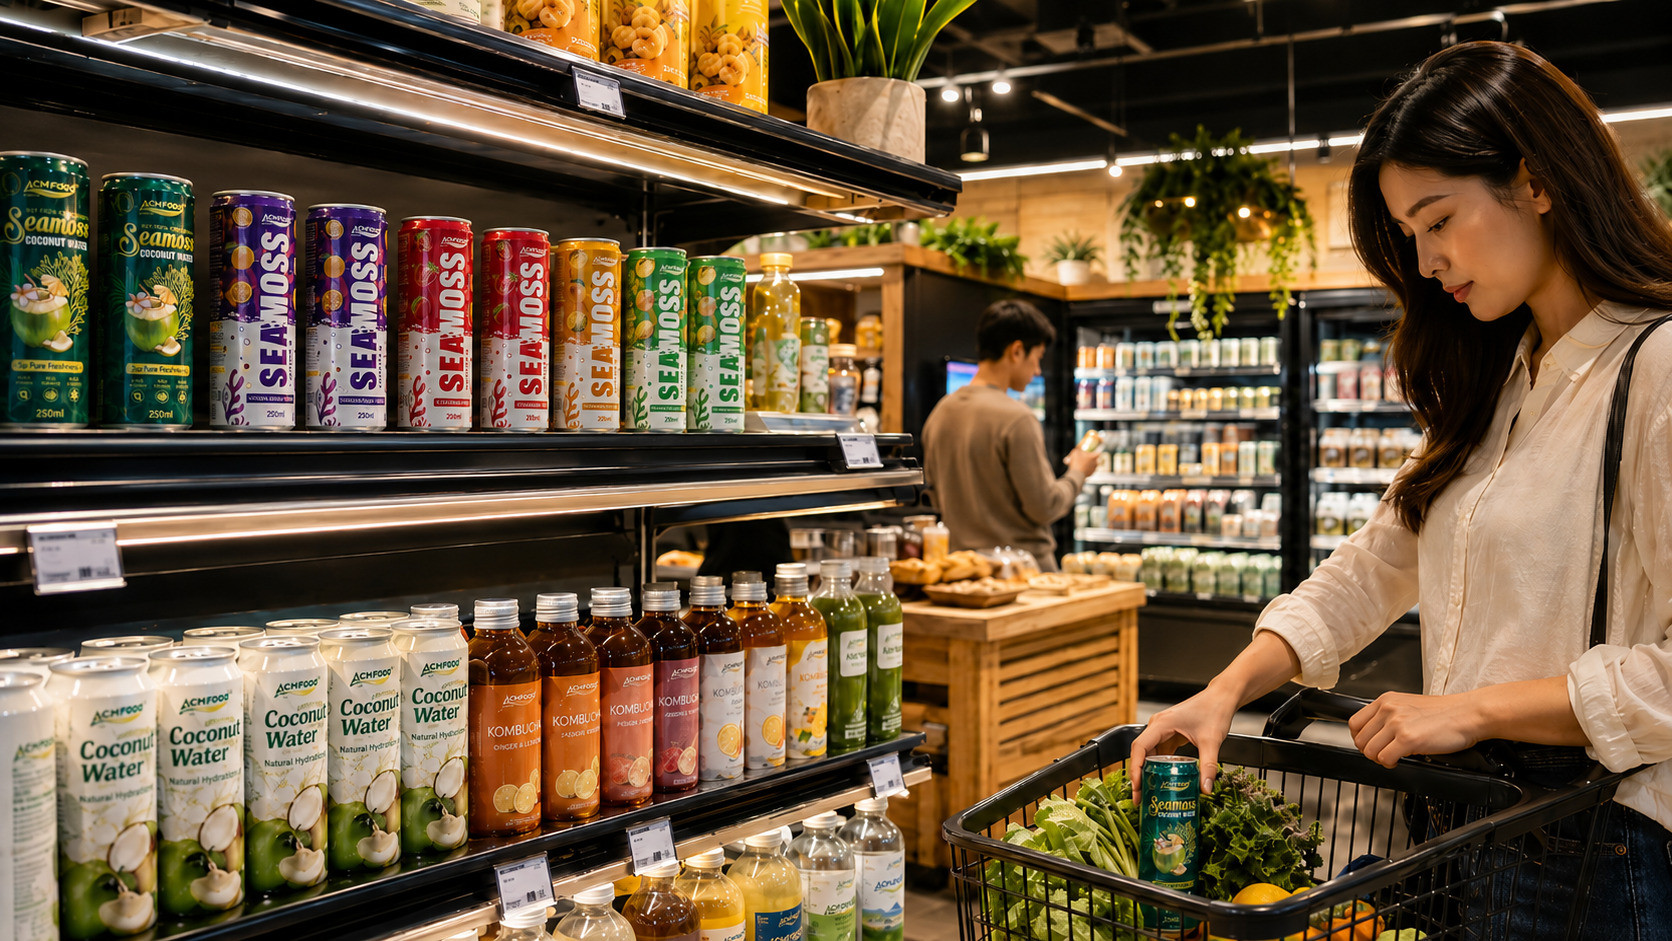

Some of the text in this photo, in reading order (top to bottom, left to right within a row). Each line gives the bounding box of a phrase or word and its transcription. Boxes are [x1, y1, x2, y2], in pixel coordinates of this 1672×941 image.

[4, 207, 89, 244] Seamoss
[25, 235, 67, 248] COCONUT
[140, 249, 176, 260] COCONUT
[259, 232, 290, 387] SEAMOSS
[350, 242, 379, 390] SEAMOSS
[438, 252, 466, 392] SEAMOSS
[519, 262, 544, 395] SEAMOSS
[591, 270, 615, 398] SEAMOSS
[658, 279, 681, 400] SEAMOSS
[719, 286, 741, 402] SEAMOSS
[36, 408, 64, 419] 250ml
[149, 410, 173, 419] 250ml
[340, 692, 399, 716] Coconut
[412, 683, 467, 704] Coconut
[264, 703, 326, 728] Coconut
[413, 705, 460, 724] Water
[169, 719, 240, 745] Coconut
[341, 717, 392, 736] Water
[411, 731, 438, 741] Natural
[80, 730, 154, 760] Coconut
[266, 729, 318, 749] Water
[340, 745, 368, 753] Natural
[171, 746, 229, 767] Water
[264, 757, 293, 767] Natural
[81, 761, 144, 783] Water
[169, 776, 199, 785] Natural
